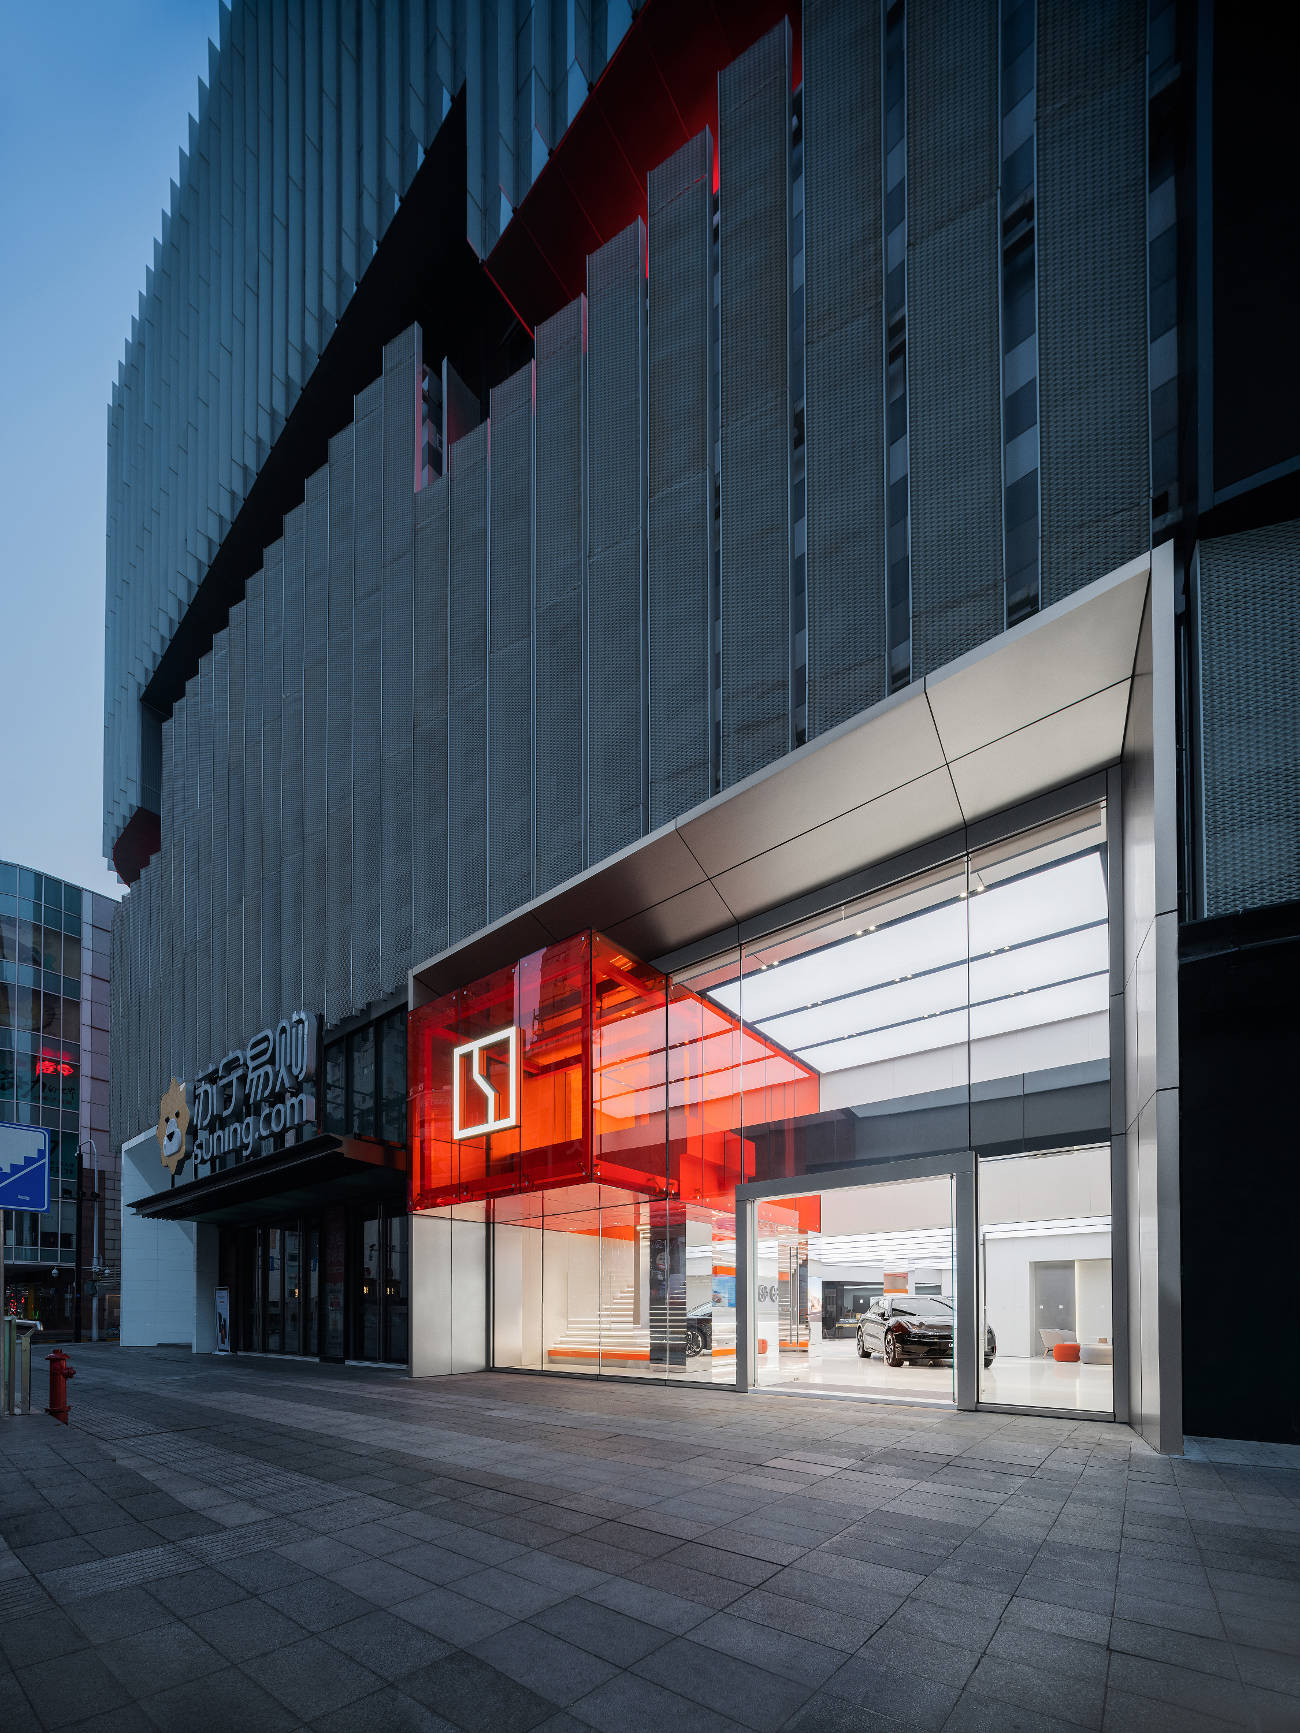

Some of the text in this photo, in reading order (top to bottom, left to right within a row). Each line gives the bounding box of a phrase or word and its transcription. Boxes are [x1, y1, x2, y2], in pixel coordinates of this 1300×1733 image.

[193, 1011, 309, 1128] 苏宁易购
[193, 1092, 308, 1165] suning.com
